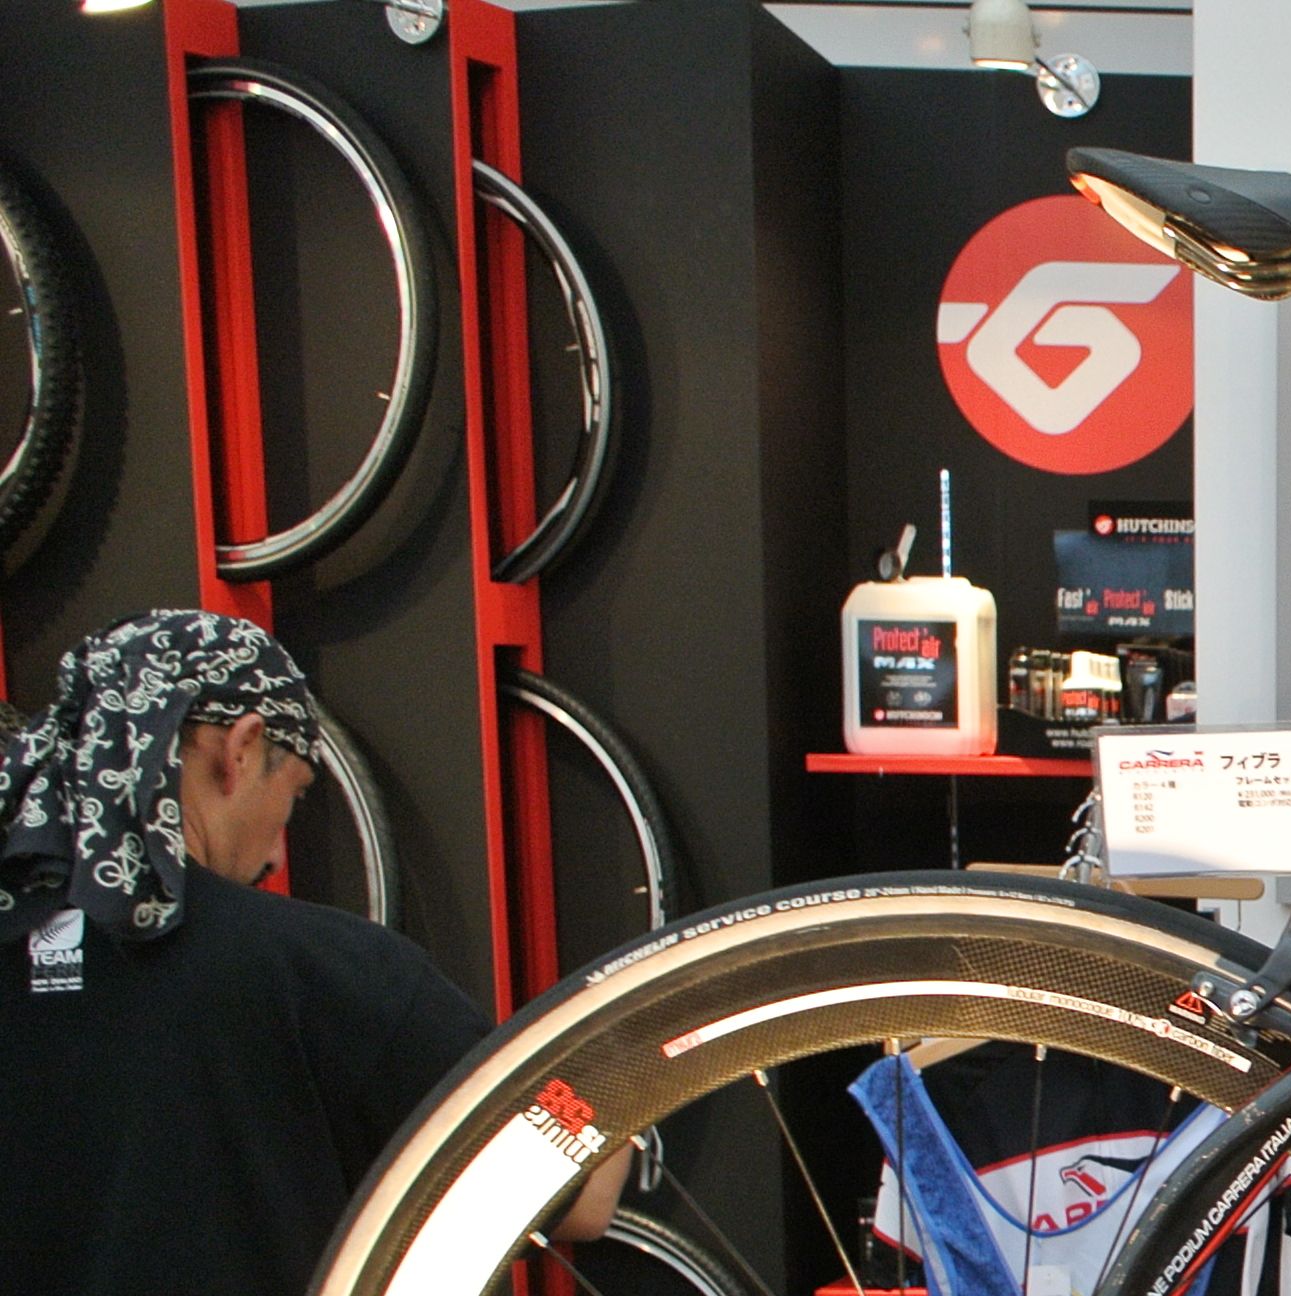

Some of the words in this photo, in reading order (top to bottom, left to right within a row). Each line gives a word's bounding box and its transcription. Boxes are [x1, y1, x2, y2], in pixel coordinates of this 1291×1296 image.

[1119, 758, 1205, 771] CARRERA
[1220, 752, 1282, 770] フィブラ
[682, 902, 772, 941] service
[774, 887, 861, 913] course
[30, 948, 84, 966] TEAM
[1163, 1218, 1215, 1285] PODIUM
[1208, 1154, 1268, 1226] CARRERA
